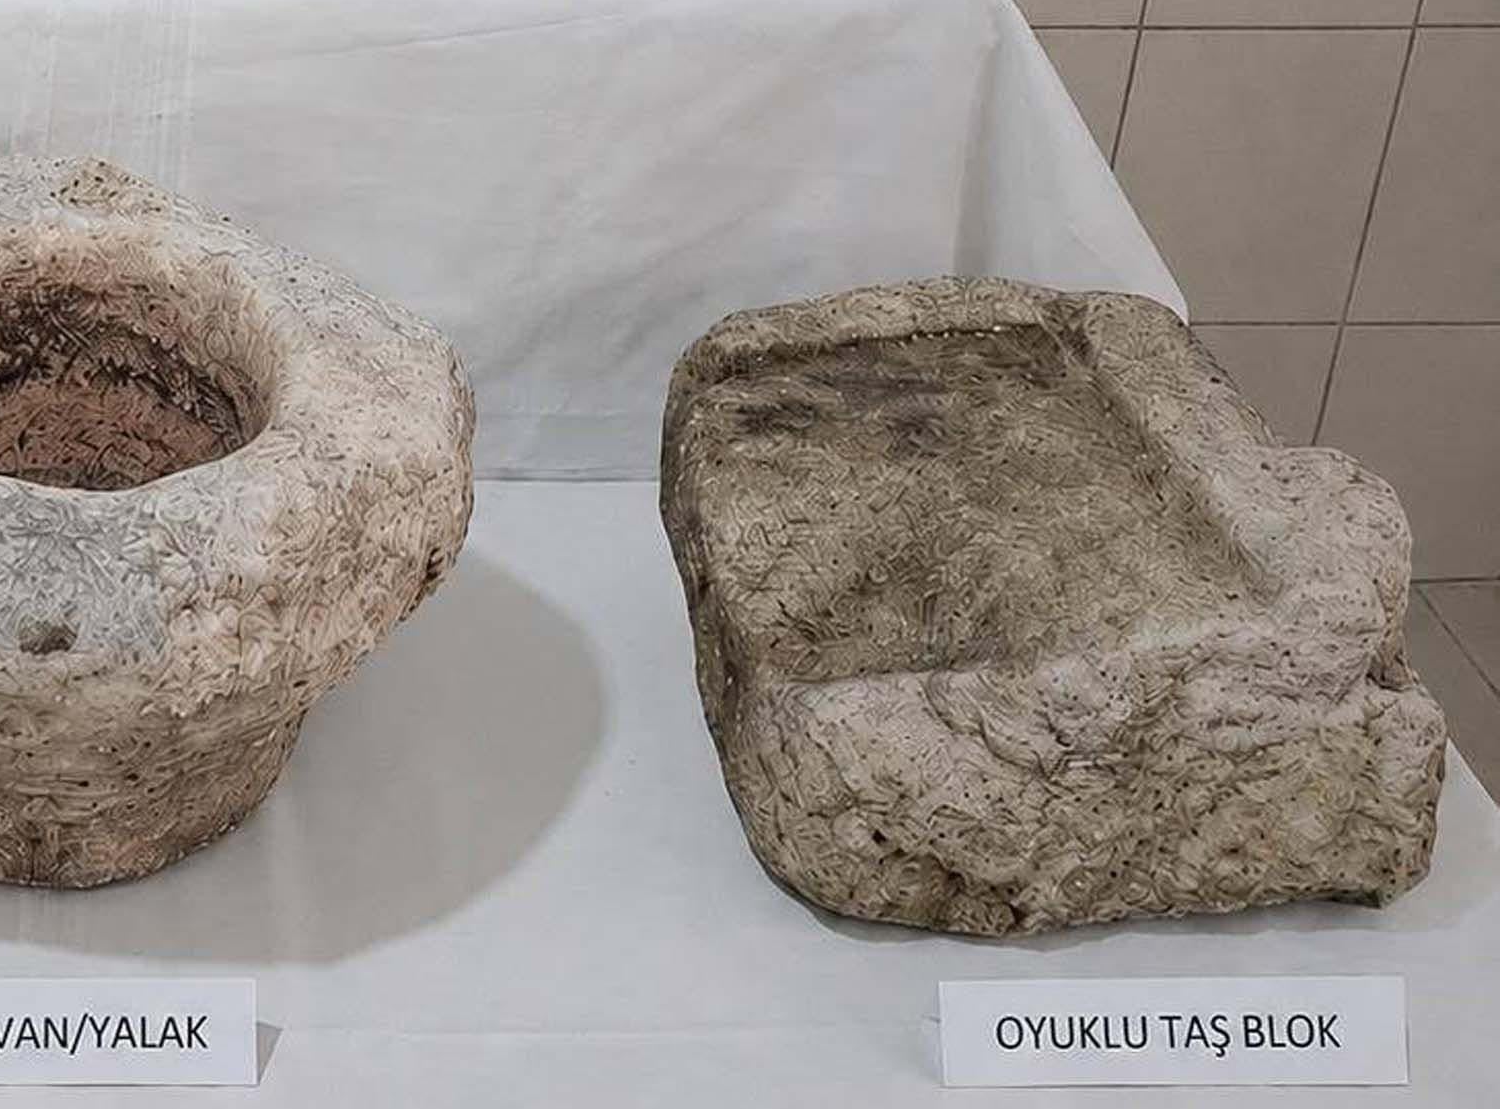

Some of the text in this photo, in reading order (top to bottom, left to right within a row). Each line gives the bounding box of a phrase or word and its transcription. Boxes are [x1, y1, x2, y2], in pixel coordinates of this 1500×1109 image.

[996, 1014, 1341, 1058] OYUKLU TAŞ BLOK
